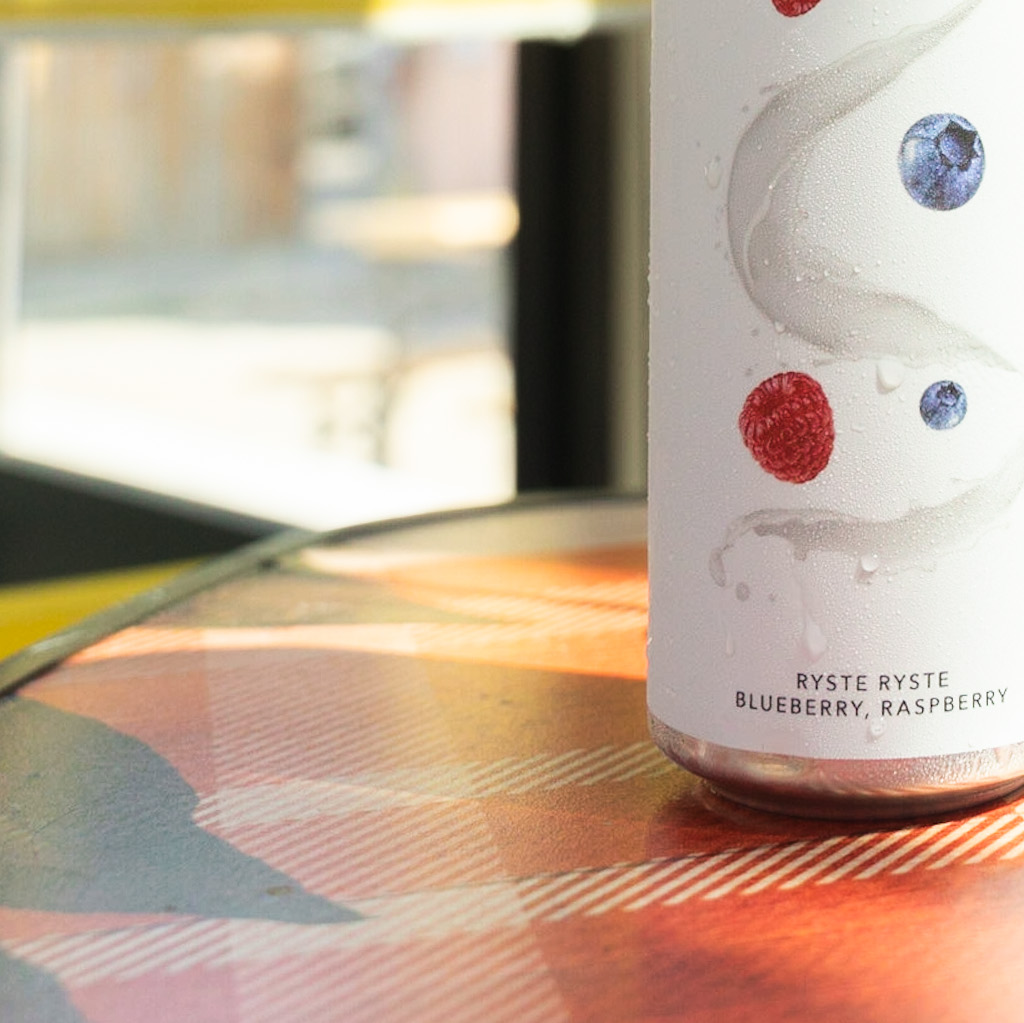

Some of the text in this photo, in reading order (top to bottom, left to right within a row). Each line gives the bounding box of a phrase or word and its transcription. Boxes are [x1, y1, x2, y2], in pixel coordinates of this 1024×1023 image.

[797, 671, 949, 691] RYSTE RYSTE
[735, 688, 1008, 719] BLUEBERRY, RASPBERRY
